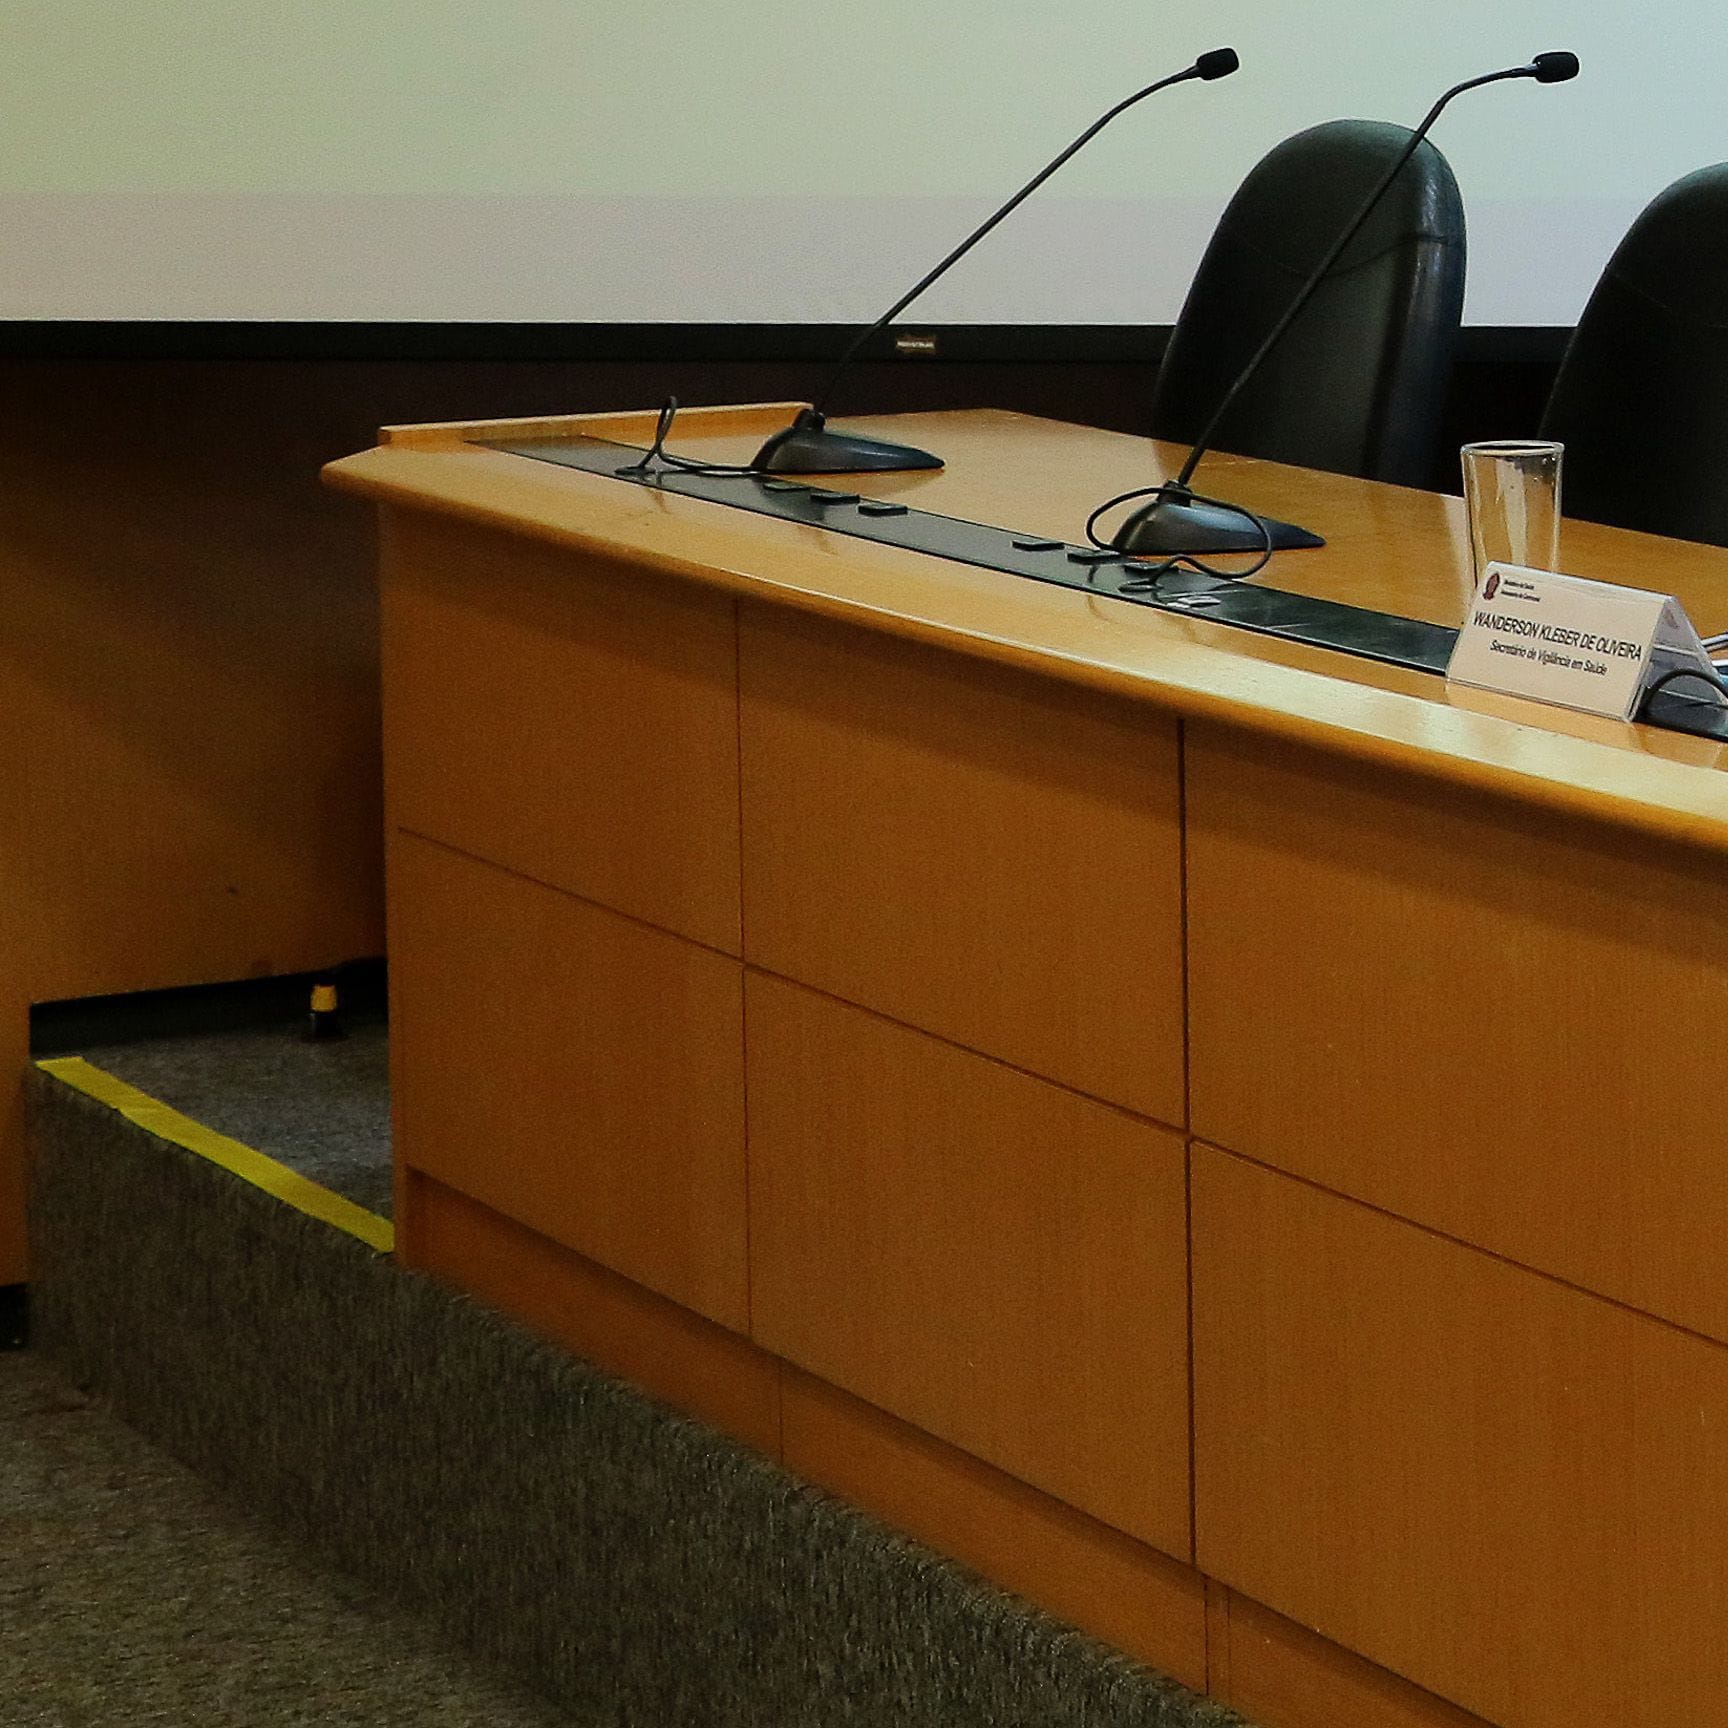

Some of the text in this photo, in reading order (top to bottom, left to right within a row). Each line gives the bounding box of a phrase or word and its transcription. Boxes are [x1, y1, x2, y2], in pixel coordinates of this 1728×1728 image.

[1473, 610, 1642, 662] WANDERSON KLEBER DE OLIVEIRA
